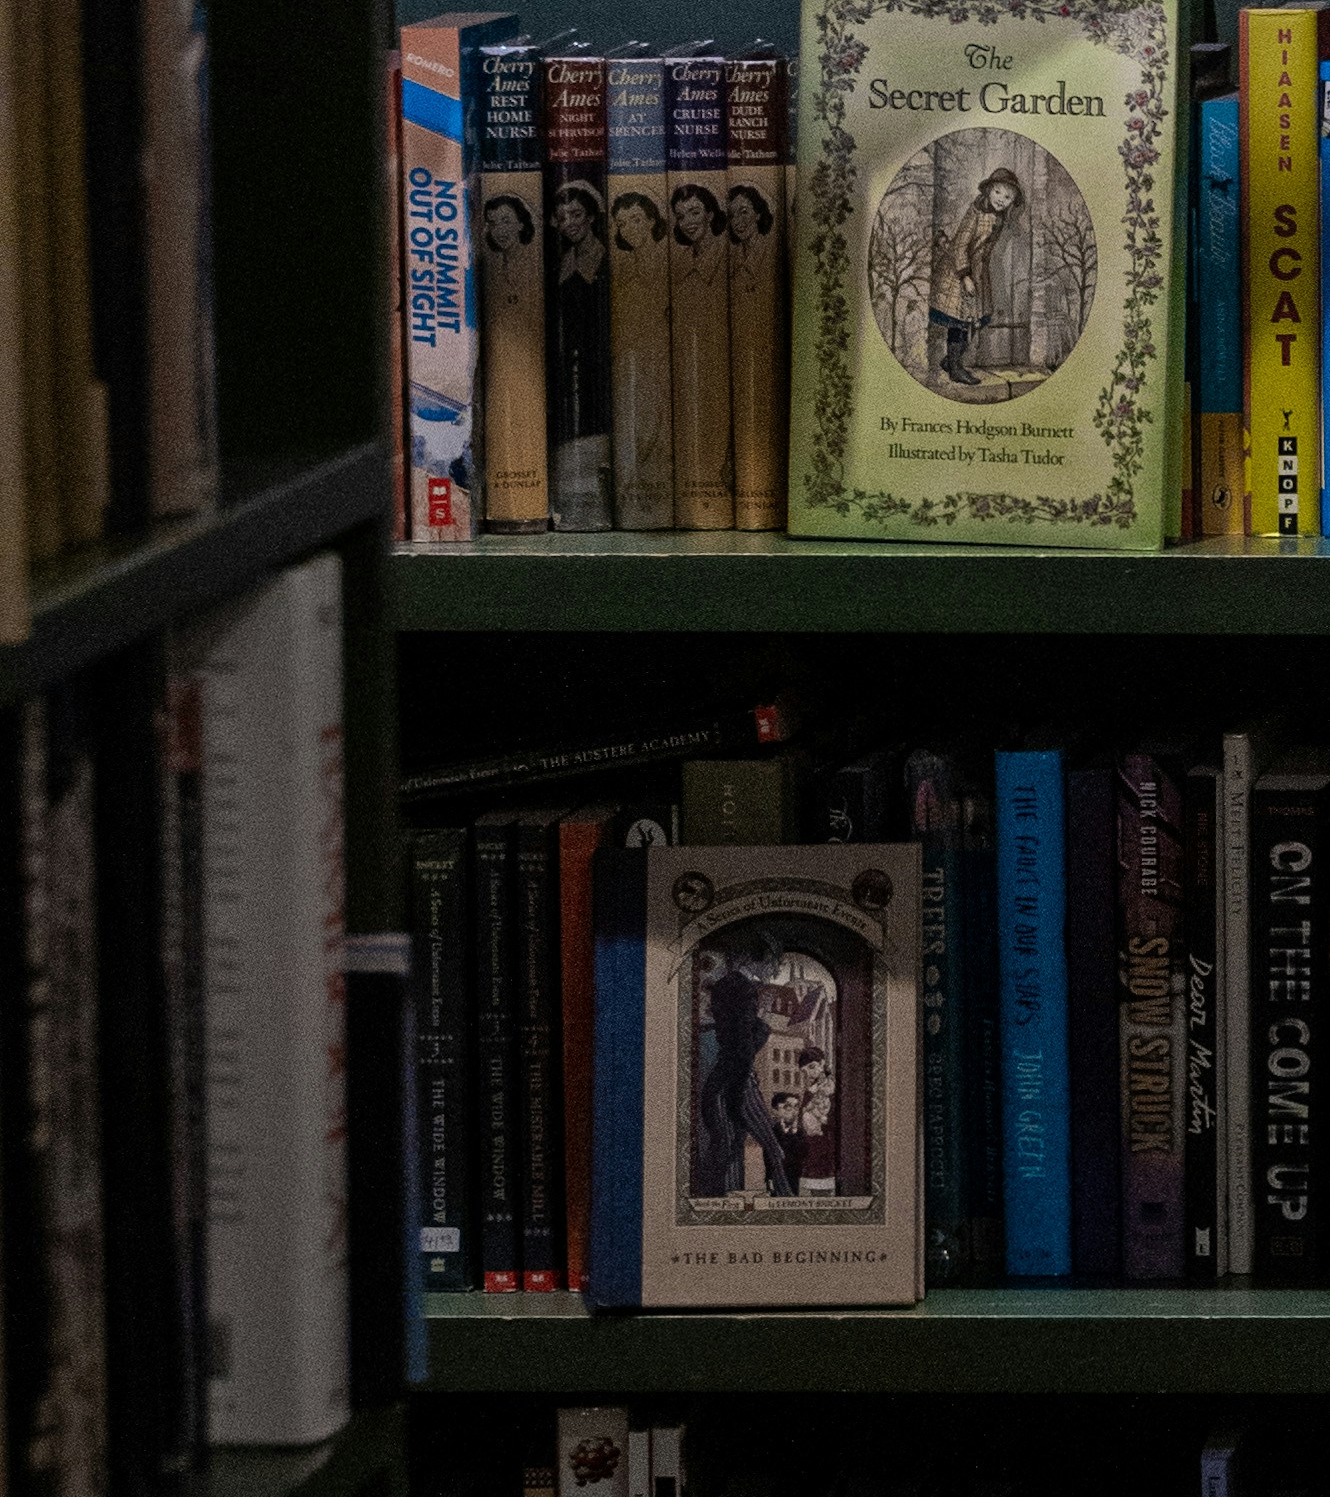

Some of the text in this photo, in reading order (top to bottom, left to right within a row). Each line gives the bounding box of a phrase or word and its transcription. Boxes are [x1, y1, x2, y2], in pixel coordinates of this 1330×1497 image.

[965, 43, 1012, 70] The
[491, 95, 527, 108] REST
[869, 79, 1106, 117] Secret Garden
[1276, 28, 1292, 173] HIAASEN
[487, 111, 532, 123] HOME
[486, 126, 537, 139] NURSE
[409, 167, 436, 347] OUT OF SIGHT
[435, 181, 460, 334] NO SUMMIT
[1269, 205, 1302, 367] SCAT
[881, 417, 1074, 439] By Frances Hodgson Burnett
[889, 444, 1065, 466] Illustrated by Tasha Tudor
[1267, 841, 1312, 1221] ON THE COME UP
[728, 1252, 763, 1264] BAD
